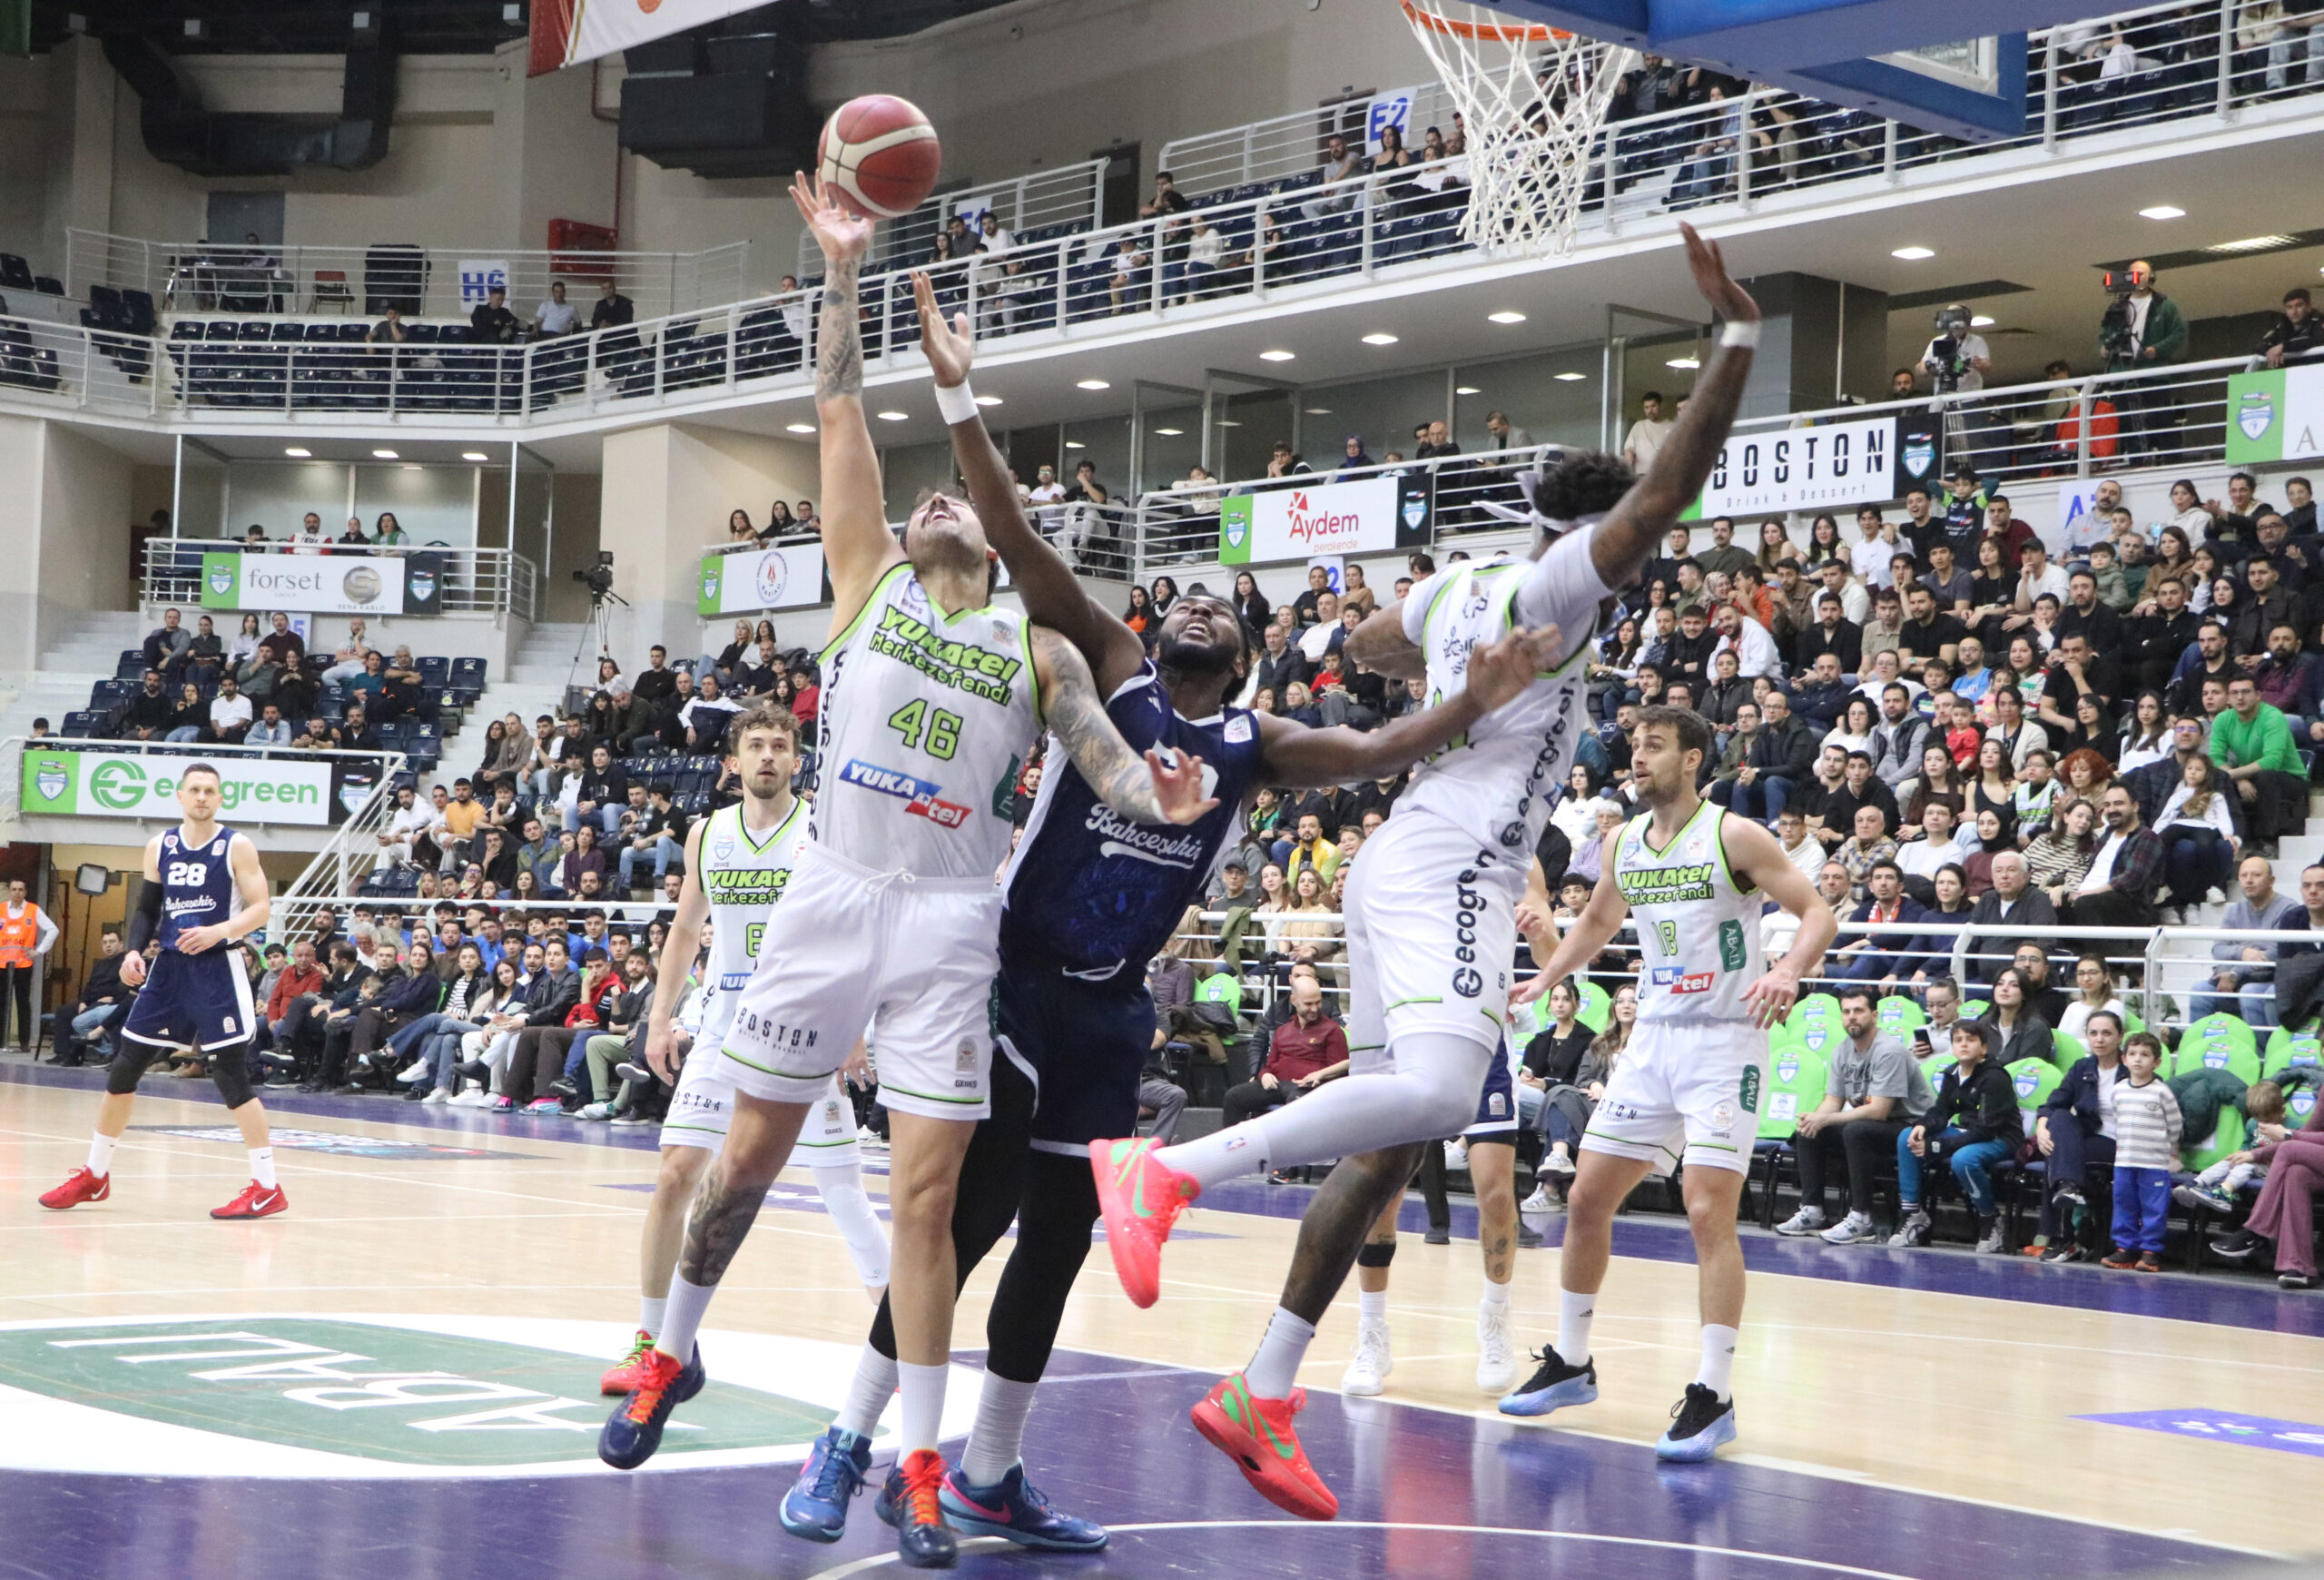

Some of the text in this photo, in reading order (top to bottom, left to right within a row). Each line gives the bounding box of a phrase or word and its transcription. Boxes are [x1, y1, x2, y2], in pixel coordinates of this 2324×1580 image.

[1370, 97, 1407, 142] E2
[462, 270, 507, 301] H6
[1713, 429, 1884, 490] BOSTON
[1727, 492, 1769, 508] Drink
[1800, 483, 1866, 501] Dessert
[1289, 510, 1359, 544] Aydem
[1314, 539, 1358, 553] perakende
[249, 568, 321, 590] forset
[869, 631, 1013, 707] Merkezefendi
[888, 697, 964, 761] 46
[850, 763, 963, 825] YUKA tel
[167, 862, 207, 886] 28
[1620, 862, 1714, 891] YUKAtel
[1725, 926, 1741, 966] ABALI
[1681, 975, 1710, 992] tel
[738, 1007, 818, 1048] BOSTON
[1746, 1070, 1758, 1109] ABALI
[45, 1330, 708, 1433] ABALI
